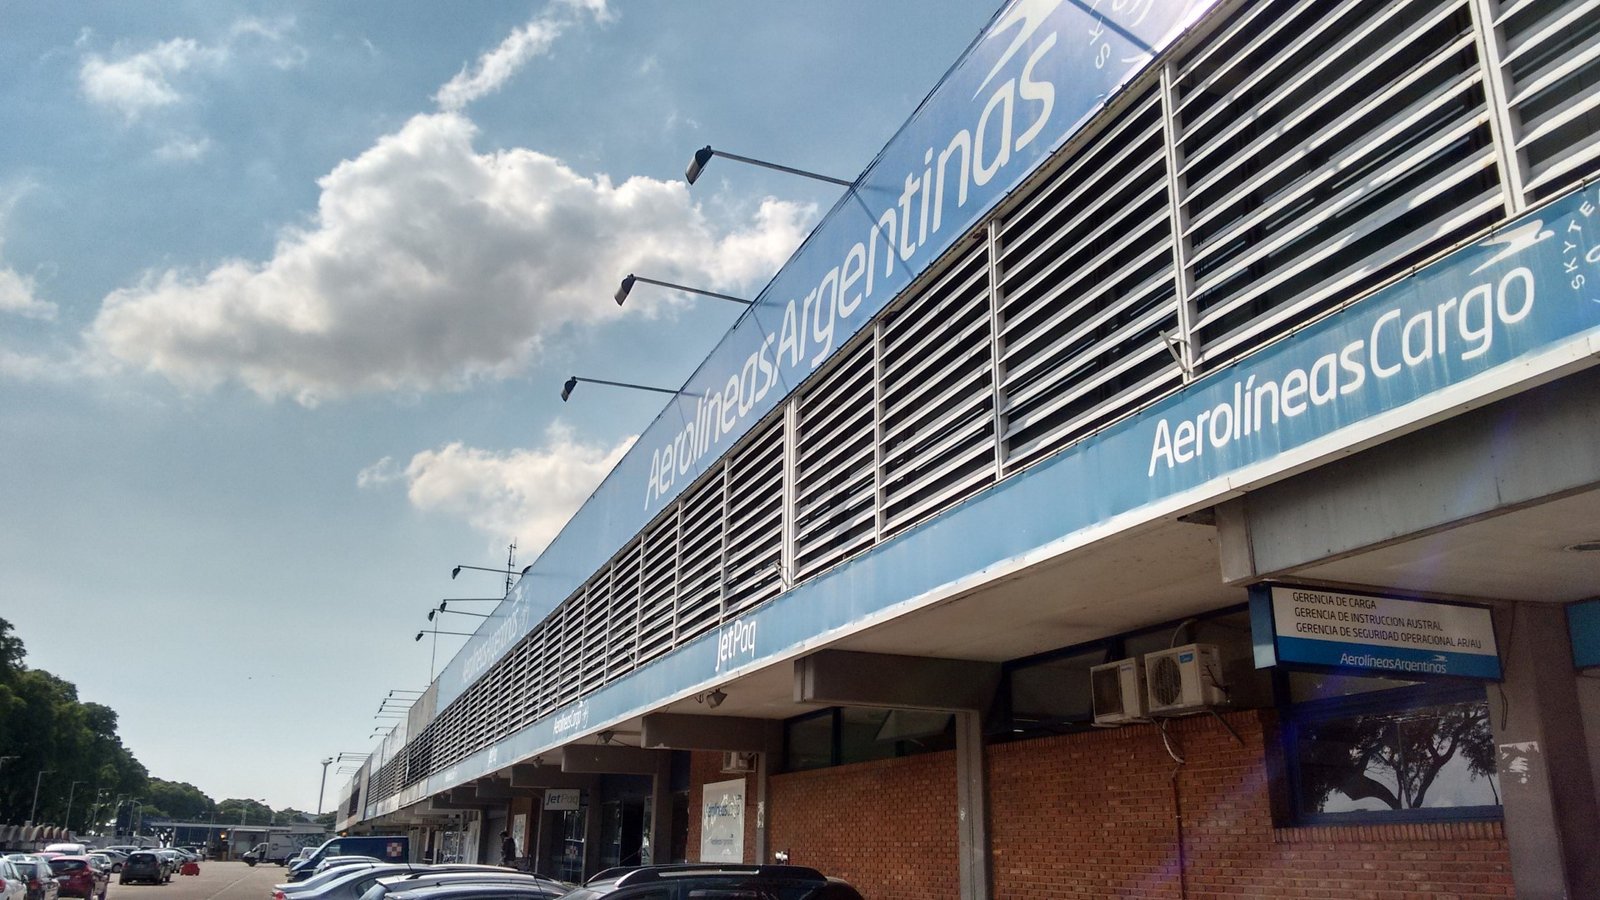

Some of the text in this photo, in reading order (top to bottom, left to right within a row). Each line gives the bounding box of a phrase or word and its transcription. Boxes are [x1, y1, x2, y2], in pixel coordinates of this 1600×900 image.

[1563, 189, 1600, 290] SKYTE
[644, 31, 1058, 512] AerolíneasArgentinas
[1148, 266, 1535, 478] AerolíneasCargo
[1293, 592, 1377, 610] GERENCIA DE CARGA
[1295, 607, 1443, 631] GERENCIA DE INSTRUCCION AUSTRAL
[715, 619, 757, 673] JetPaq
[1296, 622, 1339, 636] GERENCIA
[1340, 627, 1352, 637] DE
[1352, 628, 1400, 642] SEGURIDAD
[1400, 633, 1456, 647] OPERACIONAL
